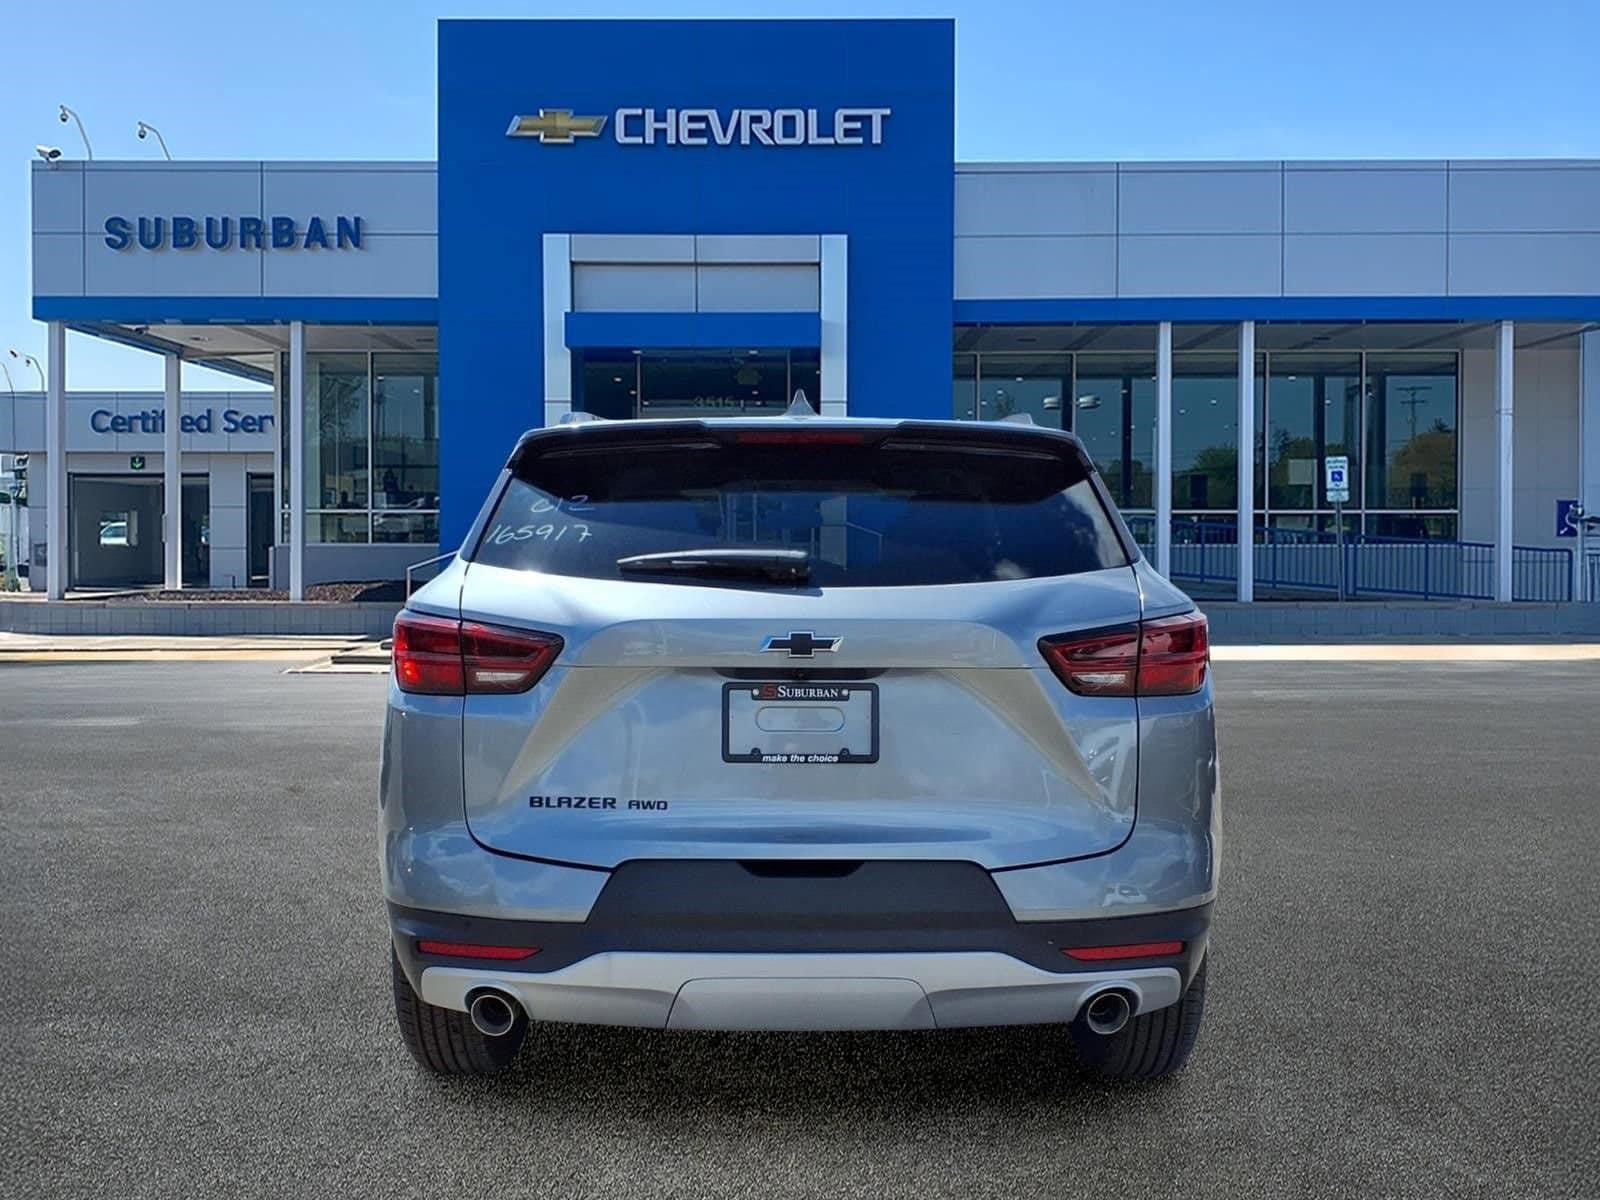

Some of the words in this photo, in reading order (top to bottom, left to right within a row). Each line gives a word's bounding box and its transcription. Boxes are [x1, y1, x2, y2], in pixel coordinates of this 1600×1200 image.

[614, 108, 892, 146] CHEVROLET
[104, 215, 365, 251] SUBURBAN
[90, 408, 213, 434] Certifed
[485, 524, 593, 545] 165917
[762, 753, 788, 762] make
[790, 753, 806, 762] the
[807, 752, 839, 762] choice
[529, 796, 617, 809] BLAZER
[628, 800, 668, 811] AWD
